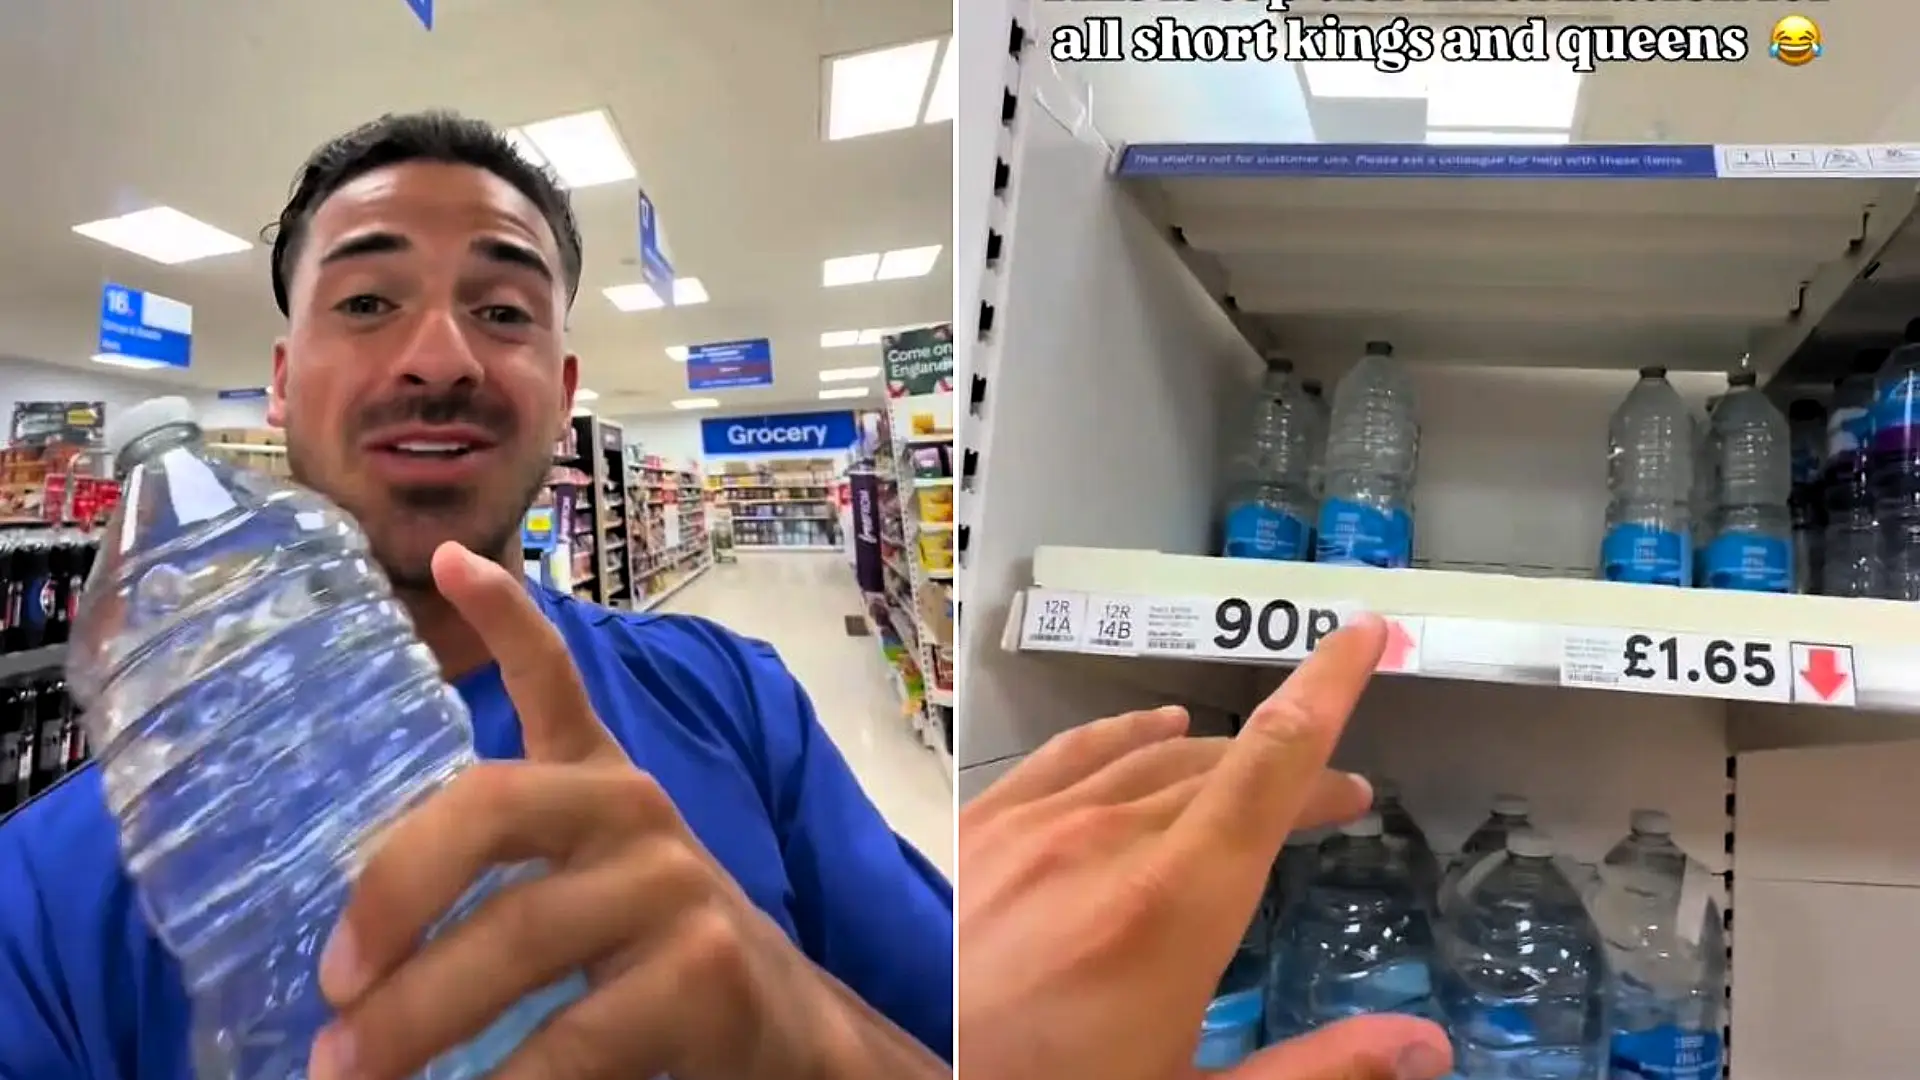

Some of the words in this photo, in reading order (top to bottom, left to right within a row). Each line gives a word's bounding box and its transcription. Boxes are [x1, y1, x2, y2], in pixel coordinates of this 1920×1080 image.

[1355, 154, 1399, 165] Please
[1565, 155, 1597, 167] with
[888, 347, 931, 362] Come
[933, 343, 952, 356] on
[892, 358, 953, 379] England
[727, 424, 828, 447] Grocery
[1045, 600, 1070, 614] 12R
[1105, 604, 1131, 619] 12R
[1038, 616, 1071, 634] 14A
[1098, 619, 1132, 639] 14B
[1213, 598, 1340, 652] 90p
[1623, 634, 1776, 687] £1.65
